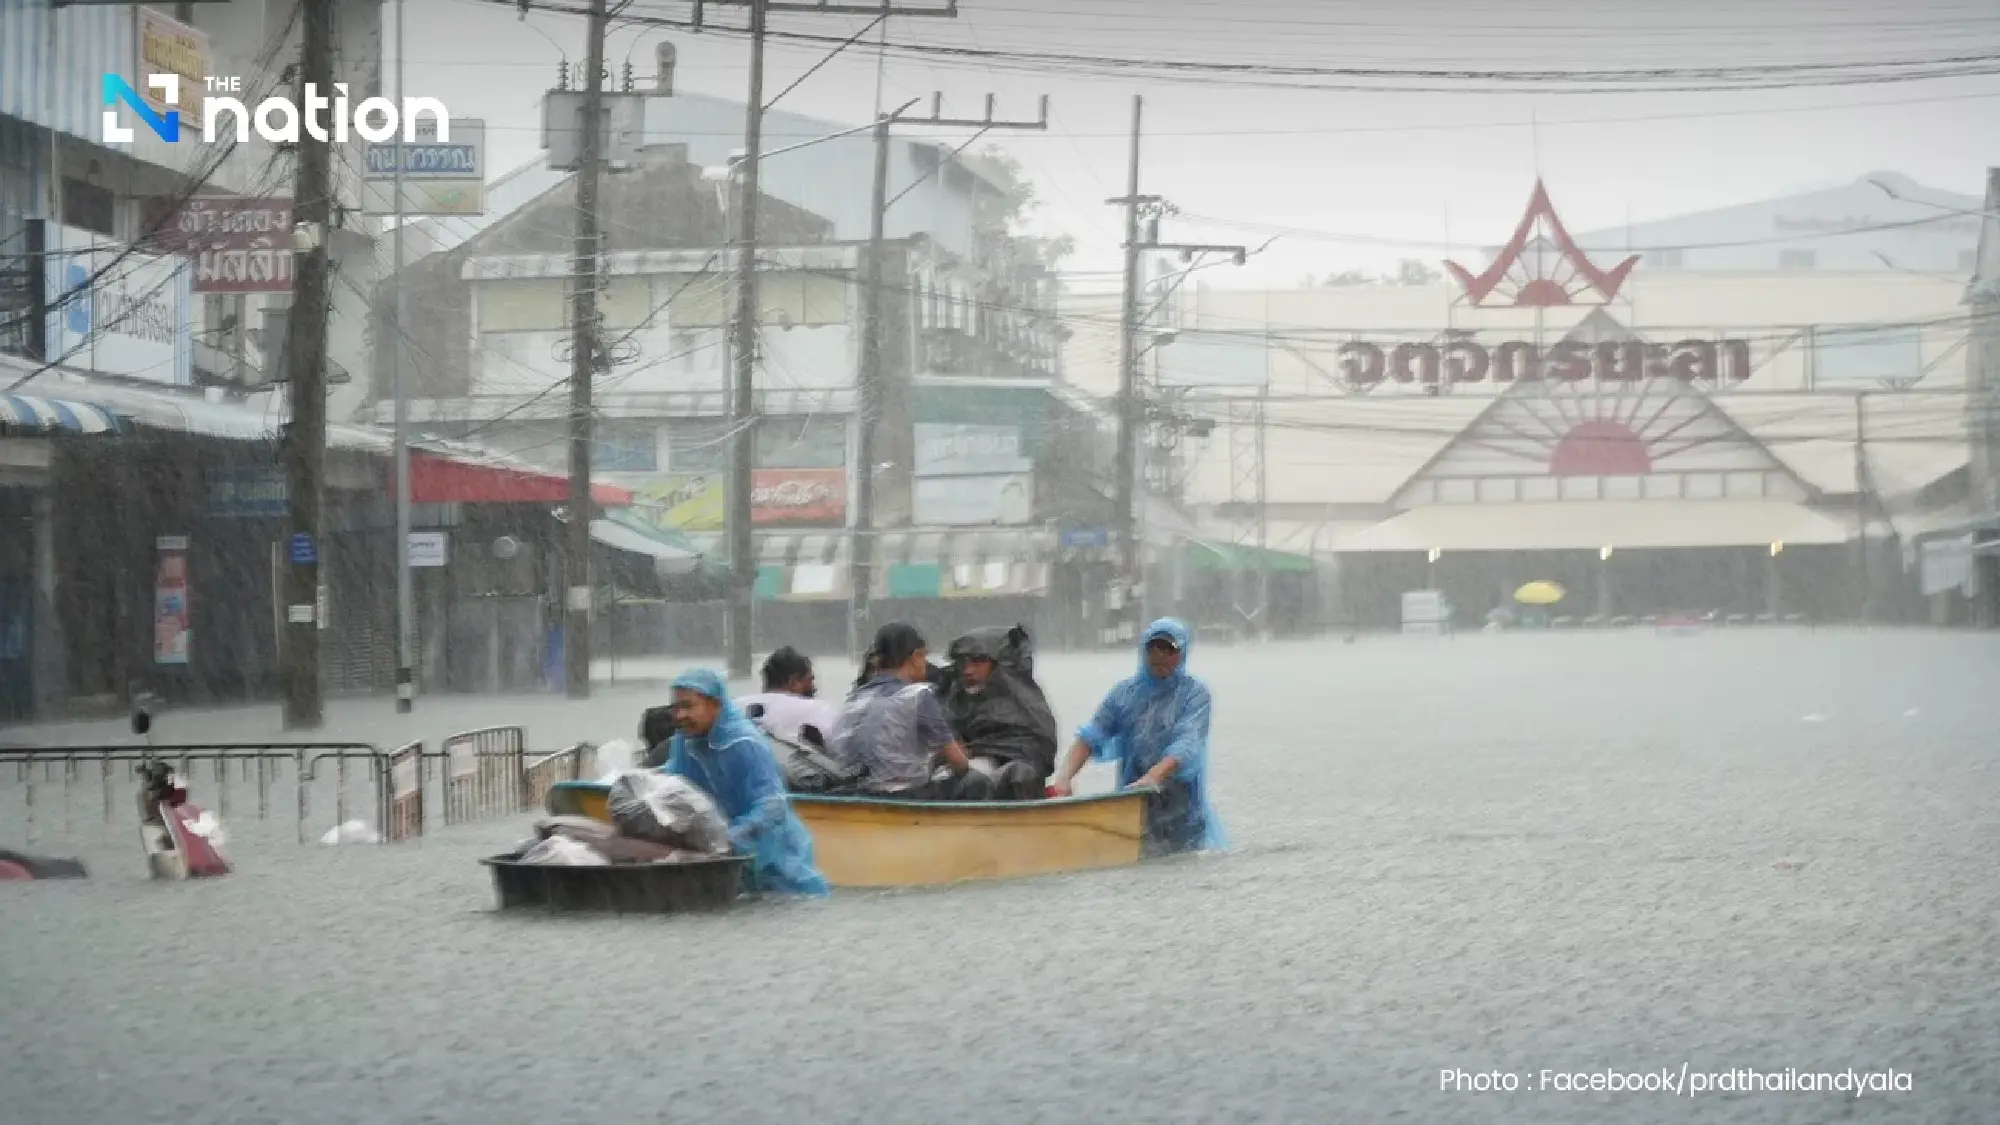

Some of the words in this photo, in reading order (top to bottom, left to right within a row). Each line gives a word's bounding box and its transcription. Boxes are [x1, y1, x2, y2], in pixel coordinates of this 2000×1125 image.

[1338, 328, 1750, 397] จตุจักรยะลา
